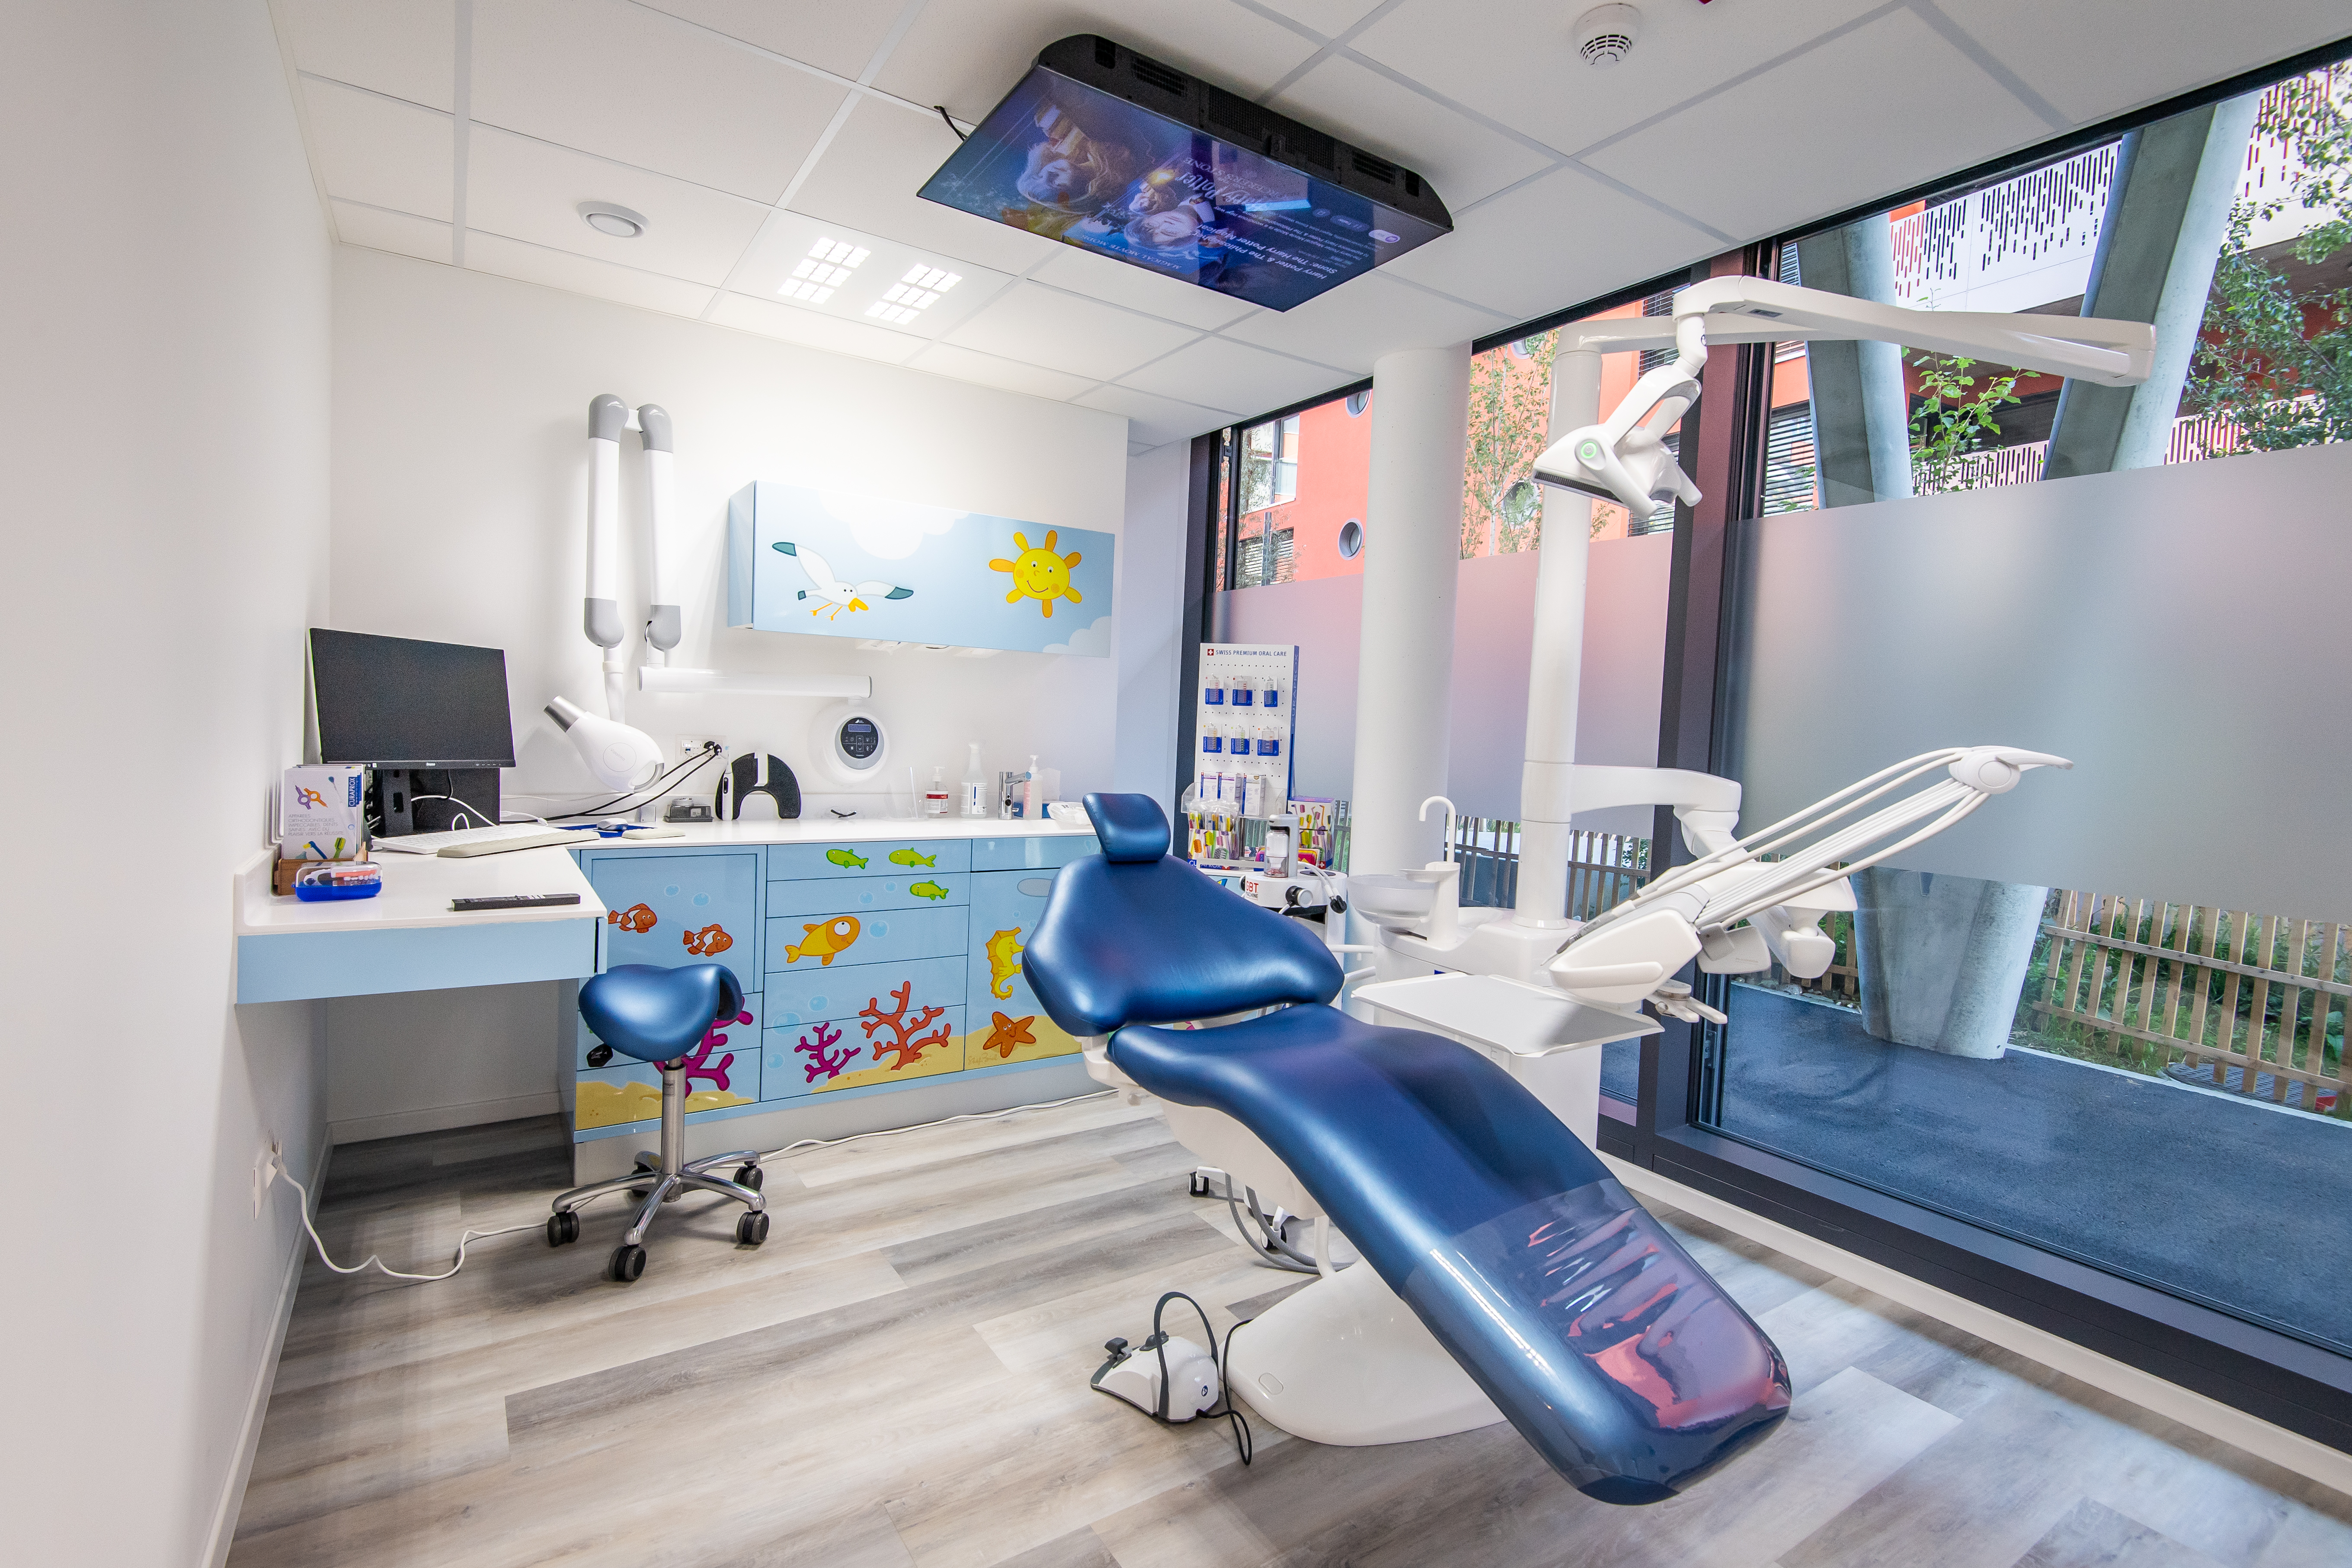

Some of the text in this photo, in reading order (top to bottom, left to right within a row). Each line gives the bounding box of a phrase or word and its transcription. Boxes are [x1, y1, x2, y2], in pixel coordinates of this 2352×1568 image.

[1196, 223, 1238, 240] Magical
[1234, 237, 1267, 250] Potter
[1079, 234, 1182, 269] MAGICAL MOVIE MODE
[1245, 250, 1268, 259] The
[1264, 246, 1294, 259] Harry
[1273, 259, 1303, 271] Potter
[1289, 256, 1311, 265] The
[1301, 268, 1329, 279] Harry
[1308, 262, 1339, 274] Stone:
[1246, 880, 1259, 893] GBT
